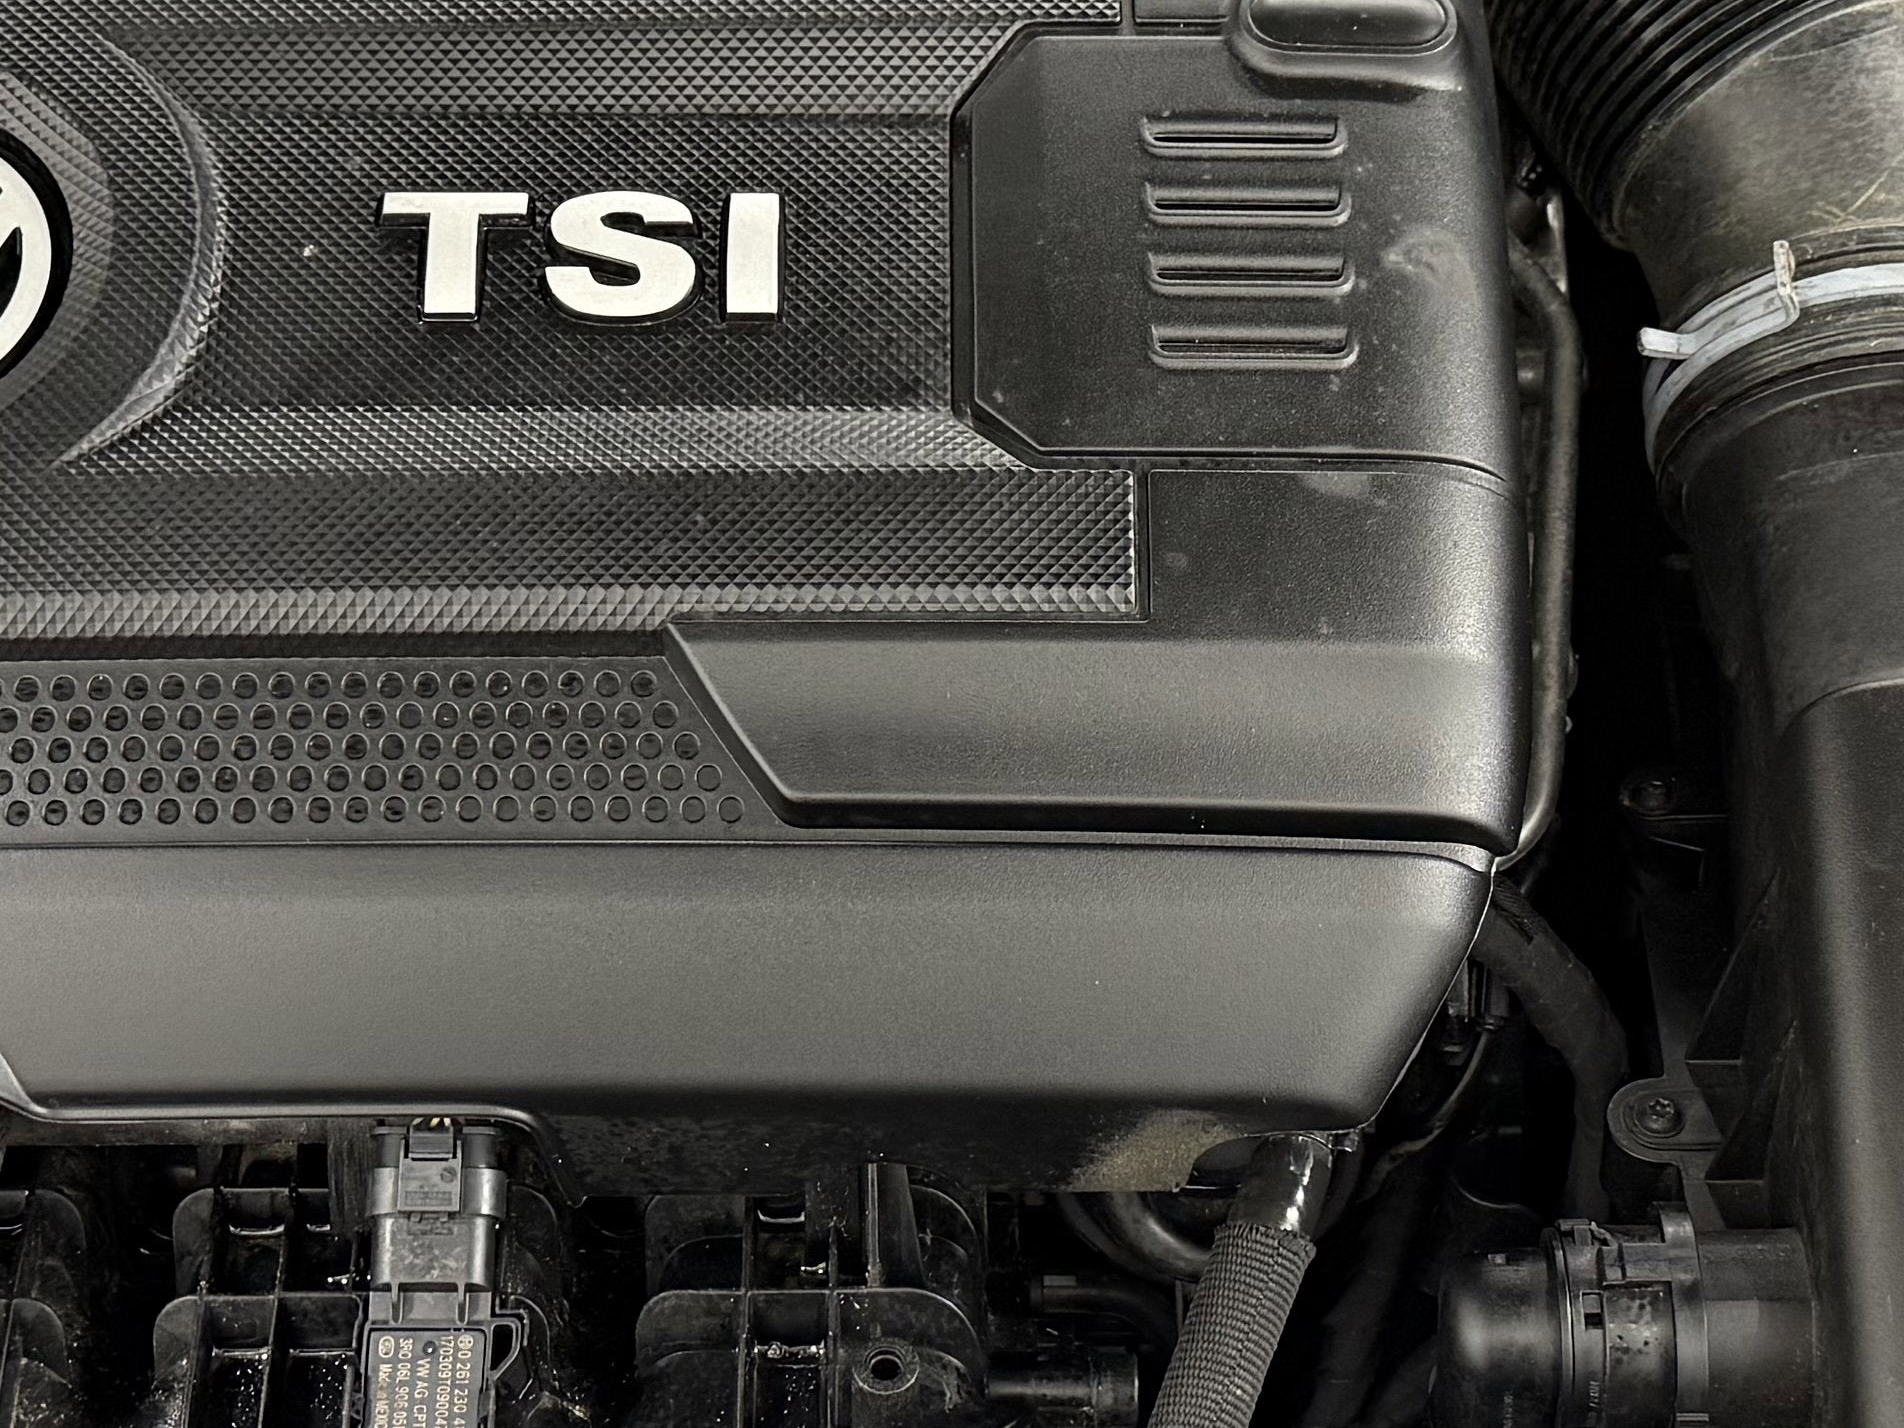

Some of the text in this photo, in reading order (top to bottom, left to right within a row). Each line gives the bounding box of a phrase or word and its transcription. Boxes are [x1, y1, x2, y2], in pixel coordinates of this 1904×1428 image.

[378, 191, 786, 324] TSI
[397, 1362, 409, 1384] 06L
[416, 1358, 431, 1378] VW
[456, 1363, 470, 1384] 261
[394, 1386, 407, 1408] 906
[415, 1381, 427, 1398] AG
[454, 1388, 468, 1413] 230
